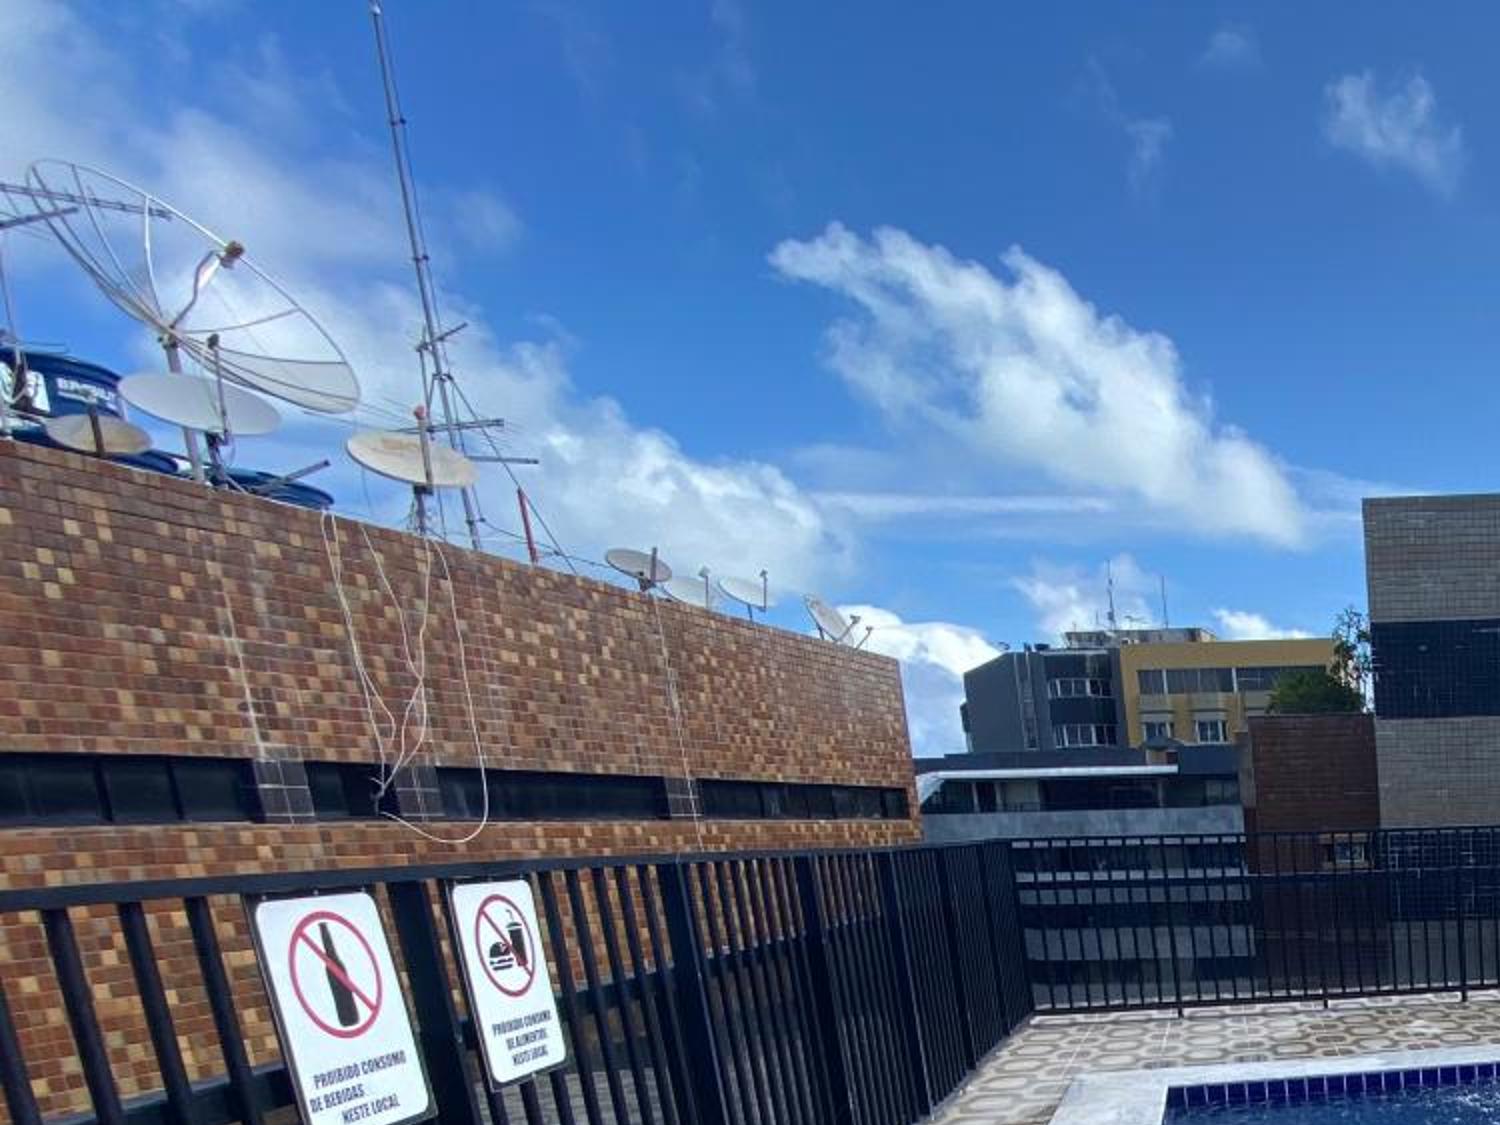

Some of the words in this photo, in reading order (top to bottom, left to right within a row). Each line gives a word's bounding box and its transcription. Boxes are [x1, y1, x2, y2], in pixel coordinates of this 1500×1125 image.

[313, 1063, 360, 1089] PROIBIDO
[361, 1050, 406, 1074] CONSUMO
[310, 1097, 323, 1112] DE
[324, 1083, 364, 1108] BEBIDAS
[342, 1103, 371, 1124] NESTE
[371, 1093, 400, 1114] LOCAL
